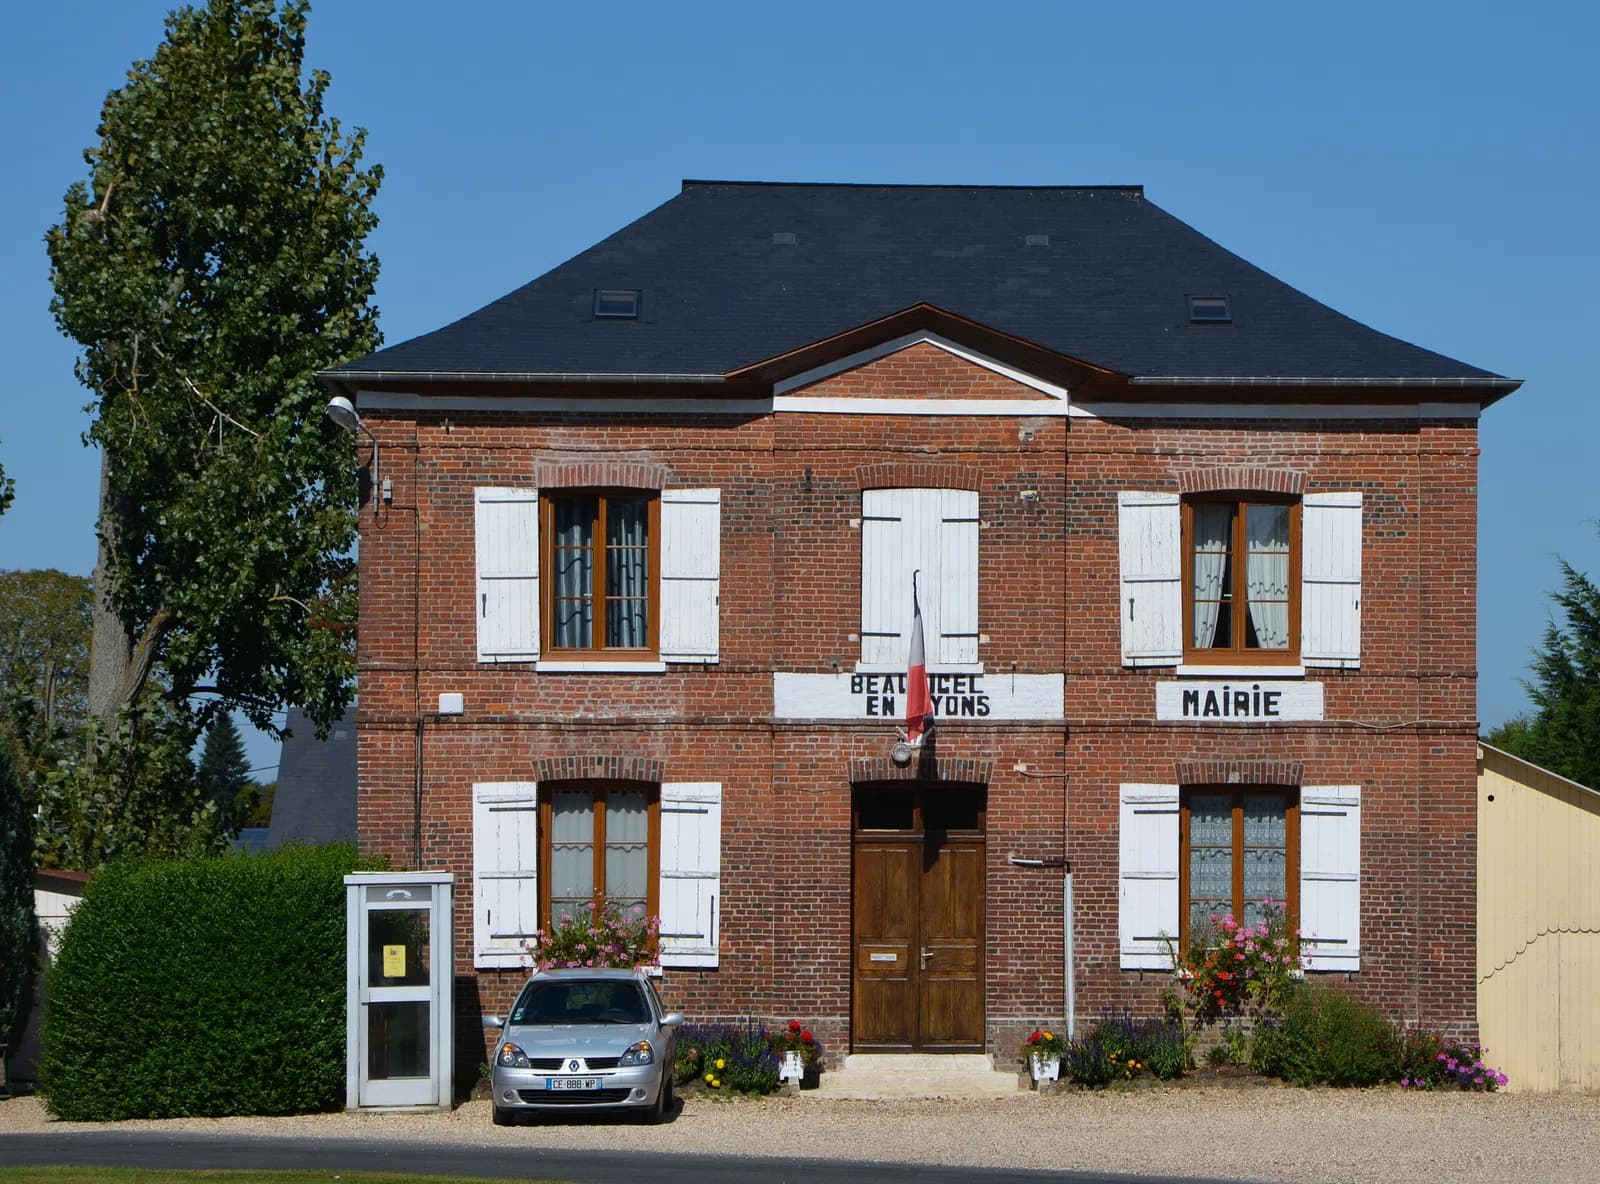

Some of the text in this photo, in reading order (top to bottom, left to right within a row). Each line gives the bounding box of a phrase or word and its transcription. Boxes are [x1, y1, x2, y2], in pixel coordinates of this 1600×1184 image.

[851, 675, 984, 694] BEAUICEL
[866, 696, 990, 716] EN YONS
